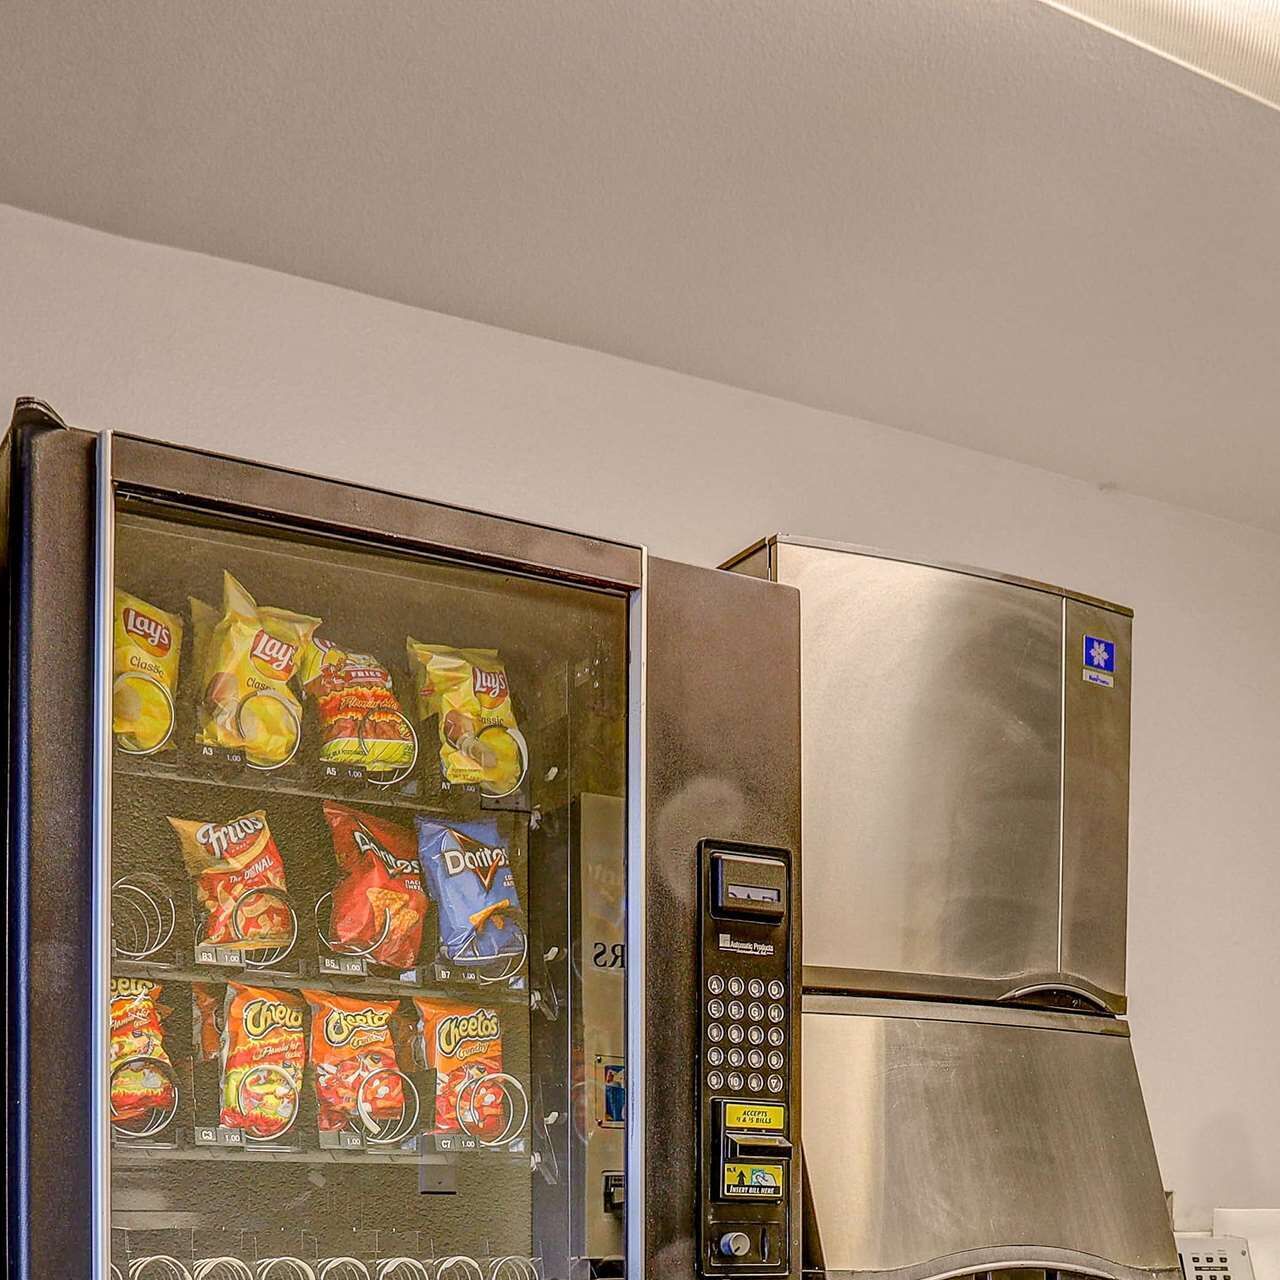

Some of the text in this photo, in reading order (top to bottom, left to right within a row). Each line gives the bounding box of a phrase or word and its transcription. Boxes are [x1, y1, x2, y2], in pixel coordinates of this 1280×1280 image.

[126, 608, 171, 646] Lay's
[474, 667, 507, 698] Lay's
[202, 746, 242, 763] A3 1.00
[326, 766, 362, 779] A5 1.00
[196, 817, 264, 859] Fritos
[201, 952, 240, 963] B3 1.00
[324, 959, 361, 972] B5 1.00
[441, 971, 451, 979] B7
[438, 1012, 499, 1054] Cheetos
[201, 1130, 241, 1143] C3 1.00
[346, 1138, 361, 1146] 1.00
[441, 1139, 476, 1149] C7 1.00
[748, 1186, 759, 1194] BILL
